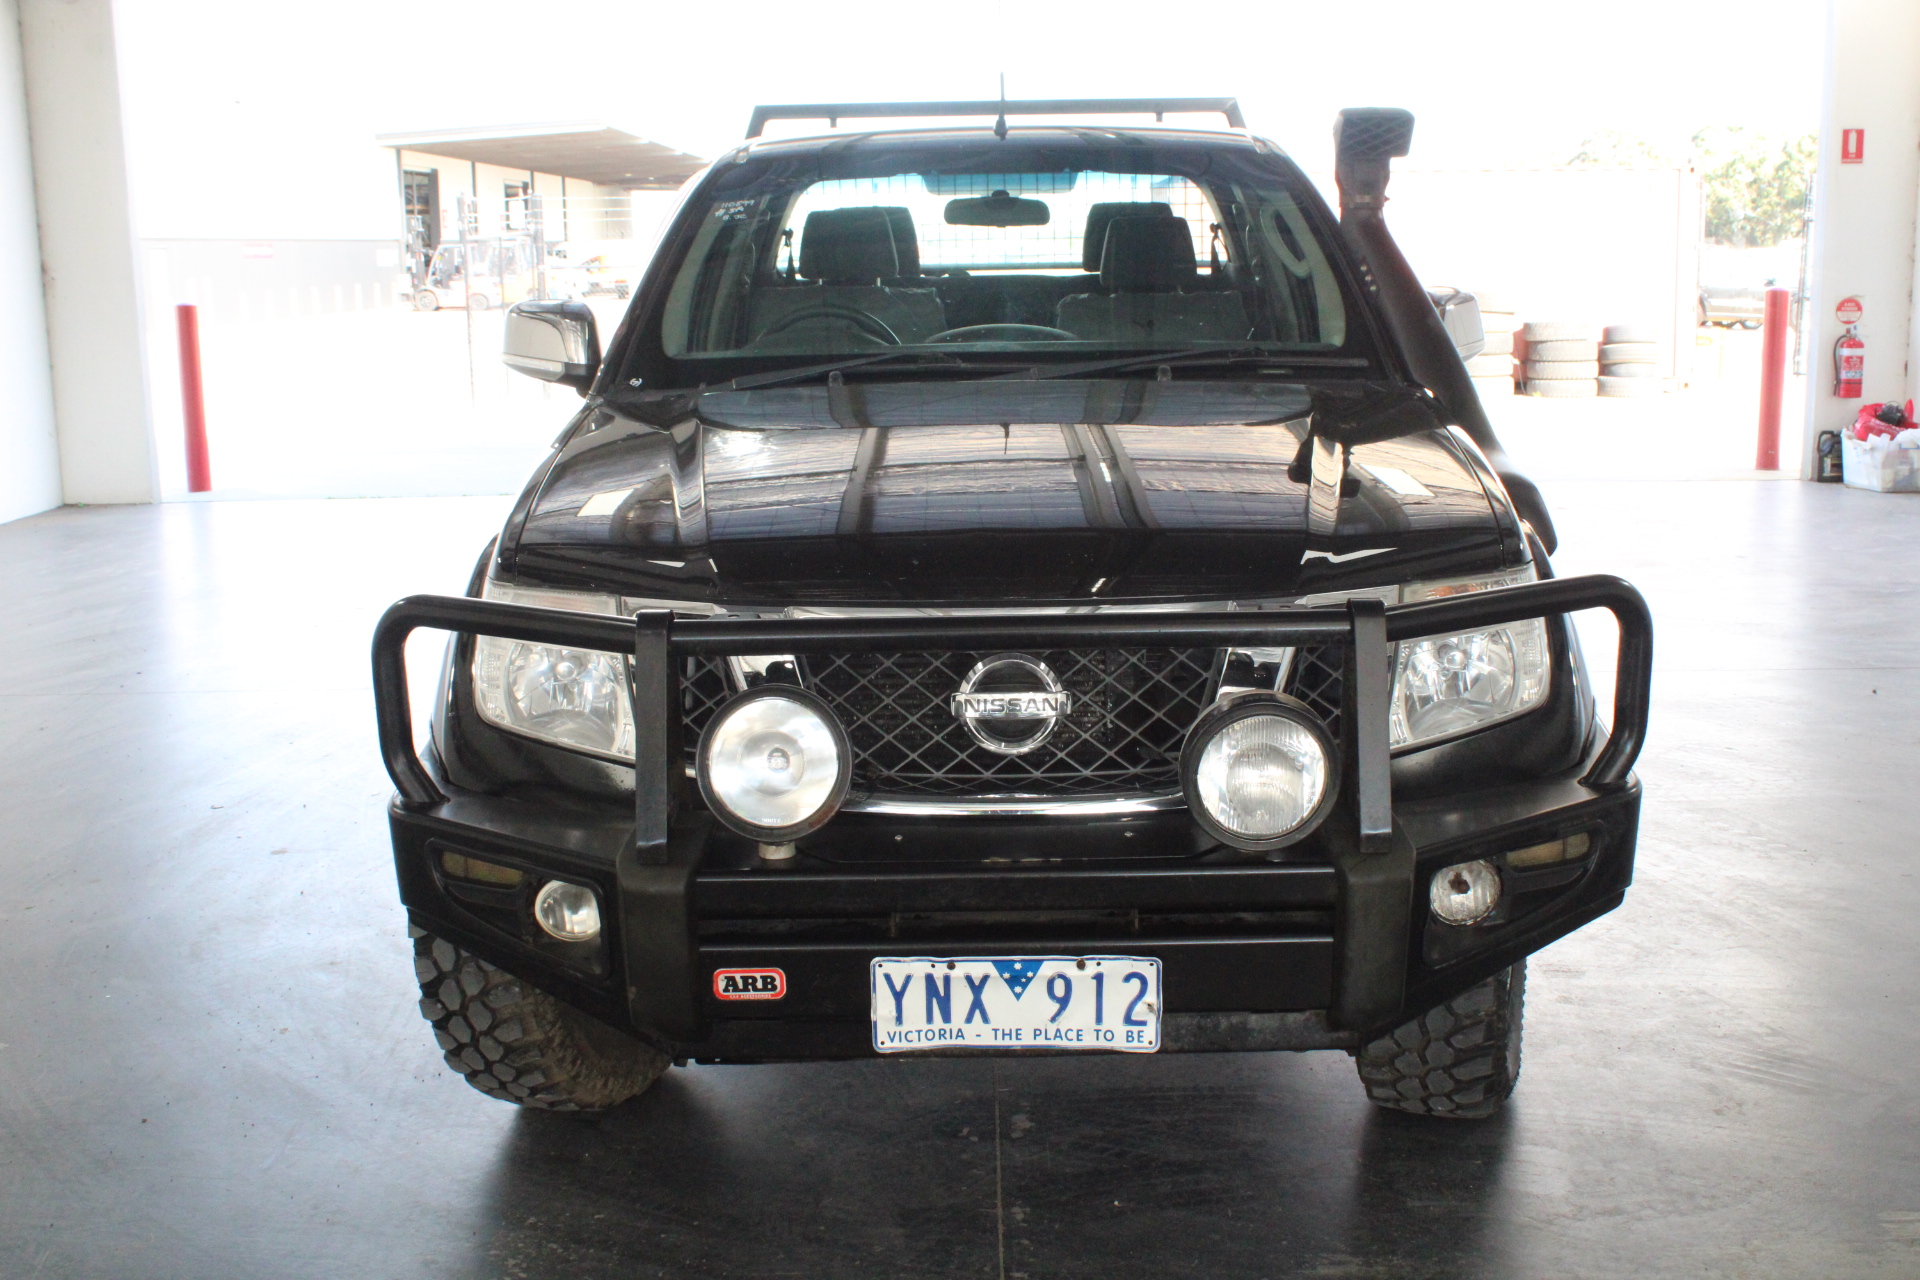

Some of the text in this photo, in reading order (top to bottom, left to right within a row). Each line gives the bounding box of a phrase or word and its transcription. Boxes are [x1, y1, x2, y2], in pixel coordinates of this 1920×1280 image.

[964, 698, 1058, 713] NISSAN
[722, 975, 778, 993] ARB
[883, 971, 1149, 1026] YNX 912
[887, 1028, 965, 1043] VICTORIA
[991, 1028, 1023, 1041] THE
[1033, 1029, 1084, 1042] PLACE
[1094, 1030, 1115, 1042] TO
[1126, 1030, 1145, 1044] BE
